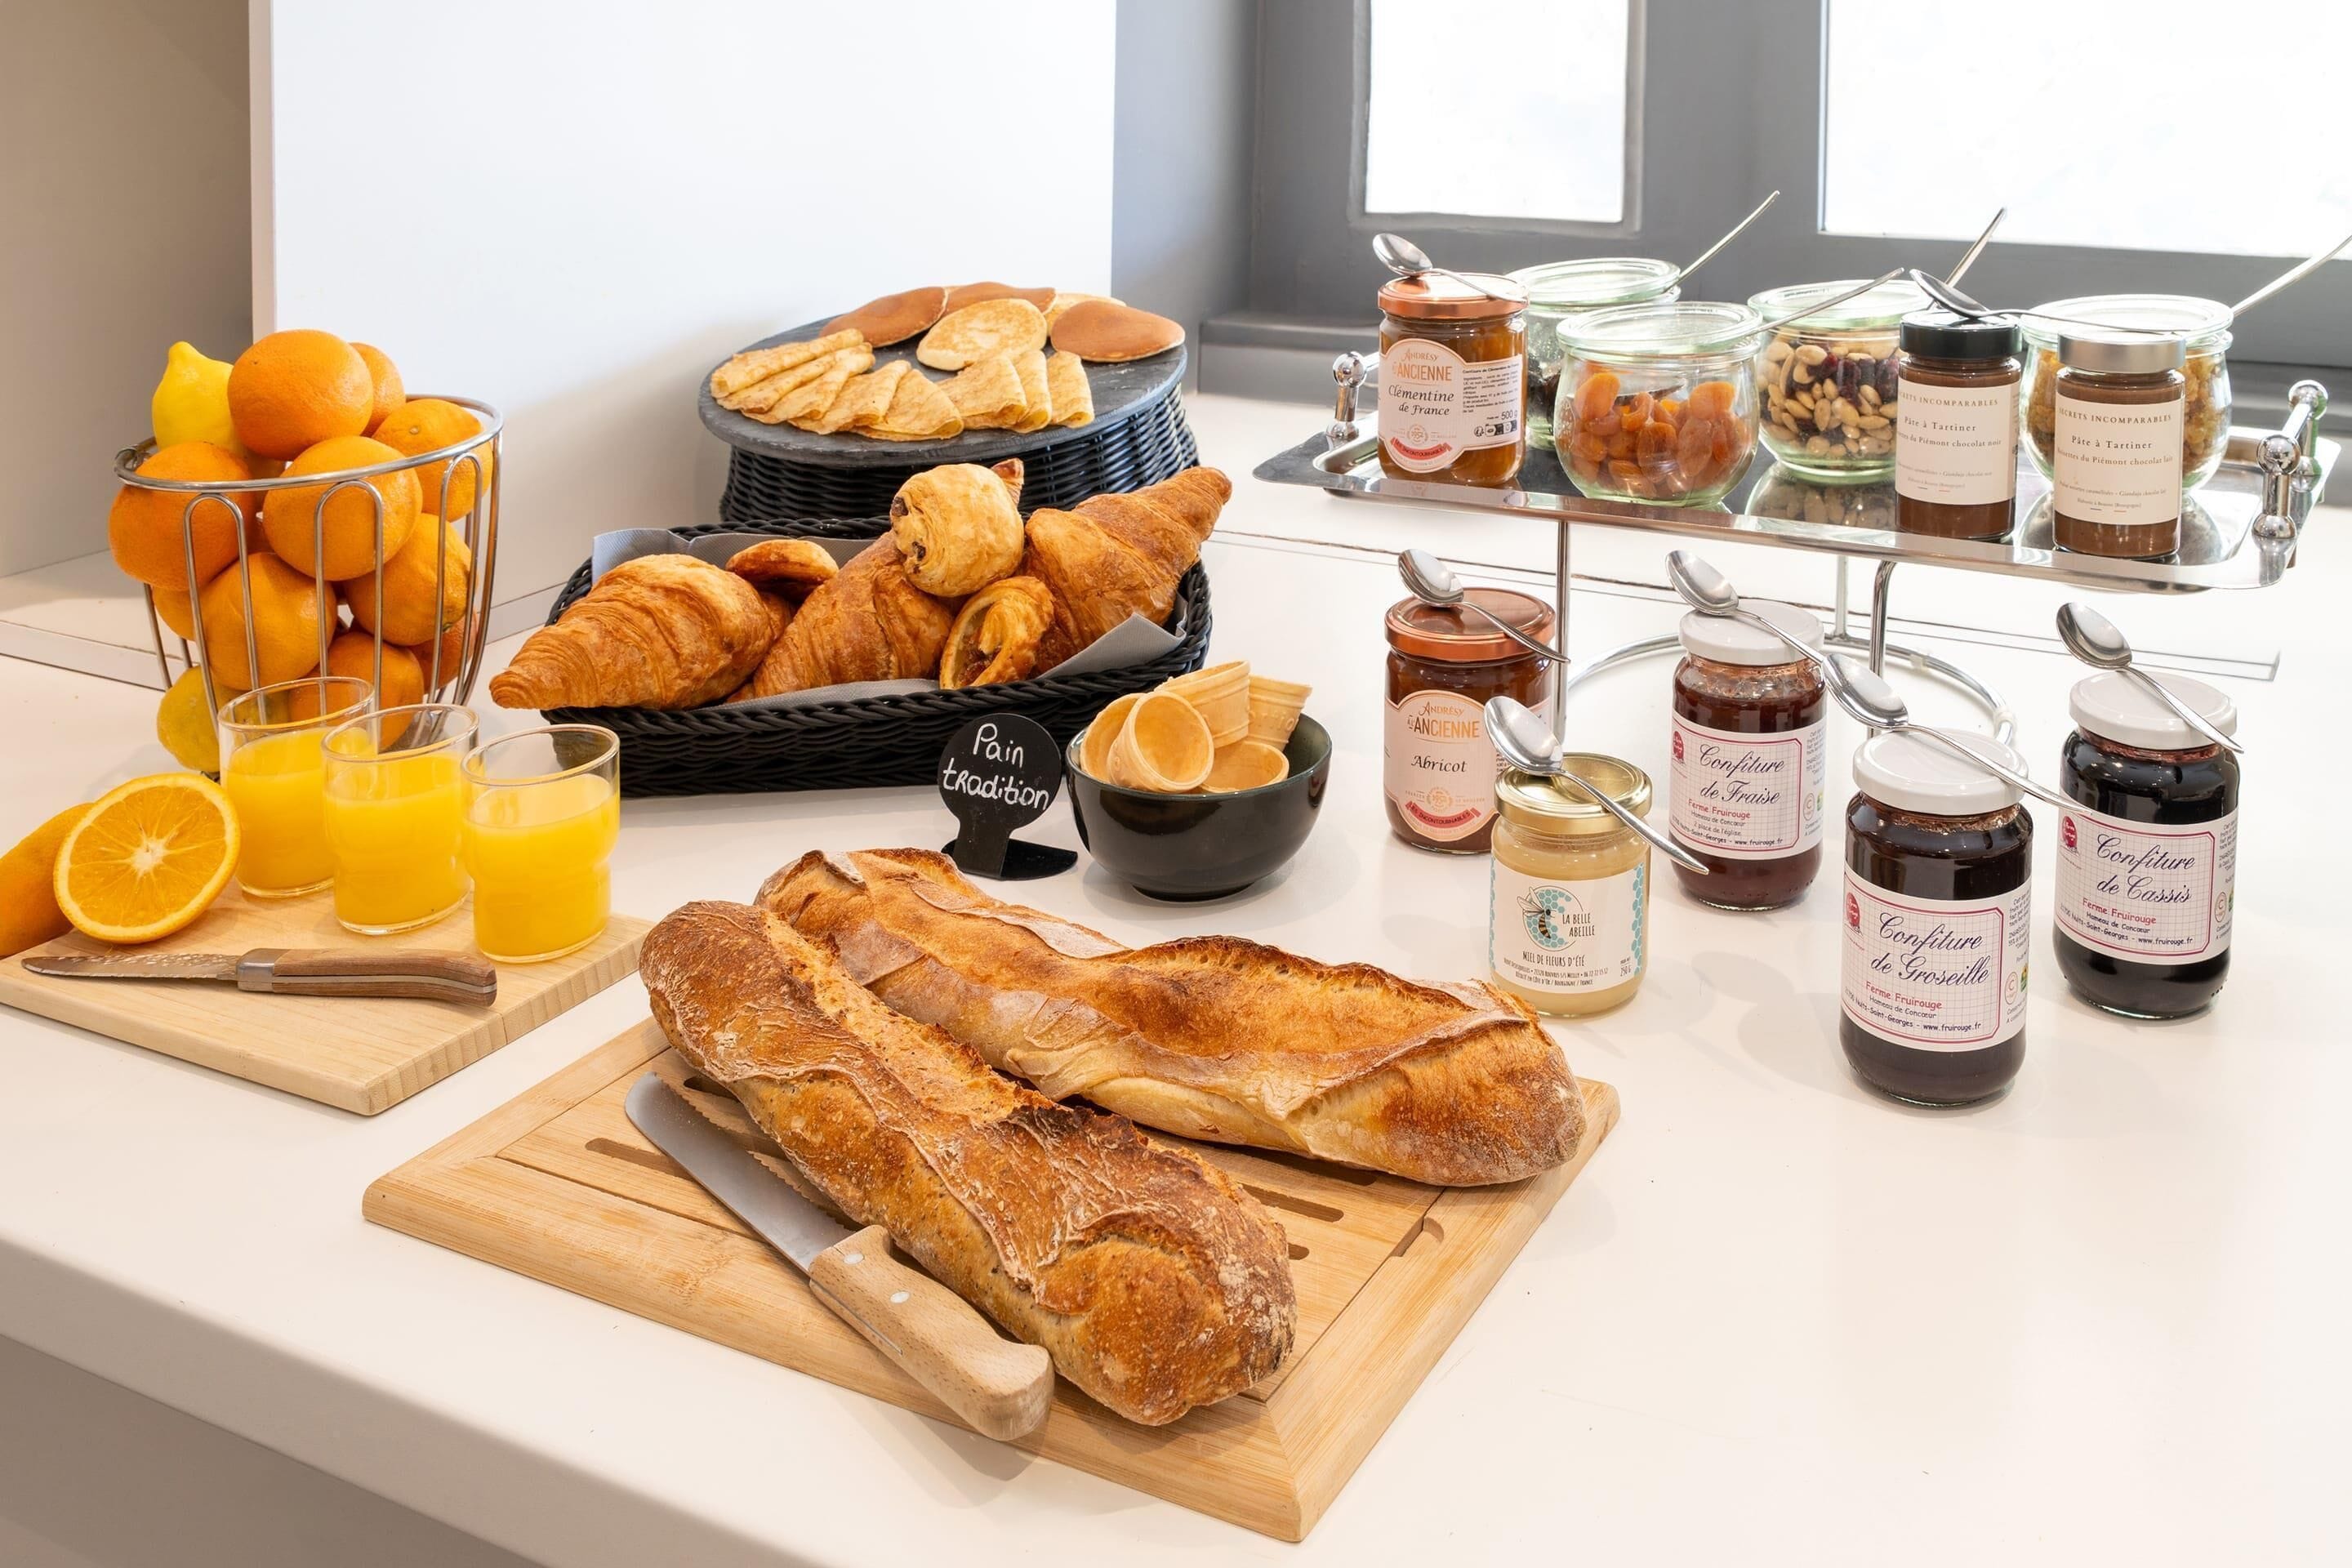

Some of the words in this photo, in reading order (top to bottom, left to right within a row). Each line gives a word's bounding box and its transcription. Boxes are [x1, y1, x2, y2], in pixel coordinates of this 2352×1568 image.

[1397, 362, 1453, 381] ANCIENNE
[1388, 385, 1454, 402] Clémentine
[1919, 397, 1998, 407] INCOMPARABLES
[1398, 402, 1410, 412] de
[1411, 405, 1450, 416] France
[1501, 410, 1513, 421] 500
[1904, 416, 1920, 426] Pâte
[1922, 420, 1927, 428] à
[1932, 421, 1977, 431] Tartiner
[2091, 414, 2172, 424] INCOMPARABLES
[1918, 436, 1949, 447] Piémont
[1952, 439, 1985, 448] chocolat
[2071, 434, 2091, 446] Pâte
[2096, 439, 2100, 448] à
[2106, 440, 2153, 449] Tartiner
[2081, 454, 2090, 463] du
[2092, 456, 2127, 466] Piémont
[2130, 456, 2163, 466] chocolat
[1418, 701, 1464, 717] ANDRÉSY
[1414, 716, 1480, 738] ANCIENNE
[973, 723, 1024, 768] Pain
[1410, 755, 1468, 773] Abricot
[1699, 743, 1784, 778] Confiture
[942, 757, 1050, 811] tradition
[1699, 780, 1720, 800] de
[1722, 780, 1781, 804] Fraise
[1687, 798, 1709, 813] Ferme
[1712, 806, 1751, 820] Fruirouge
[1698, 822, 1712, 831] place
[1735, 838, 1783, 847] www.fruirouge.fr
[2097, 833, 2196, 873] Confiture
[2096, 875, 2120, 894] de
[2127, 875, 2192, 903] Cassis
[1562, 914, 1570, 924] LA
[1573, 912, 1591, 924] BELLE
[2082, 897, 2107, 915] Ferme
[2111, 908, 2157, 926] Fruirouge
[2087, 911, 2109, 925] Hameau
[1569, 924, 1595, 938] ABEILLE
[1879, 912, 1982, 955] Confiture
[2071, 914, 2128, 940] Nuits-Saint-Georges
[2138, 937, 2193, 946] www.fruirouge.fr
[1522, 951, 1535, 964] MIEL
[1536, 954, 1544, 964] DE
[1545, 956, 1566, 967] FLEURS
[1568, 954, 1585, 967] D'ÉTÉ
[1870, 952, 1893, 973] de
[1898, 953, 1991, 986] Groseille
[1865, 981, 1891, 1000] Ferme
[1895, 992, 1943, 1012] Fruirouge
[1869, 995, 1893, 1010] Hameau
[1904, 1008, 1937, 1018] Concœur
[1923, 1022, 1981, 1032] www.fruirouge.fr
